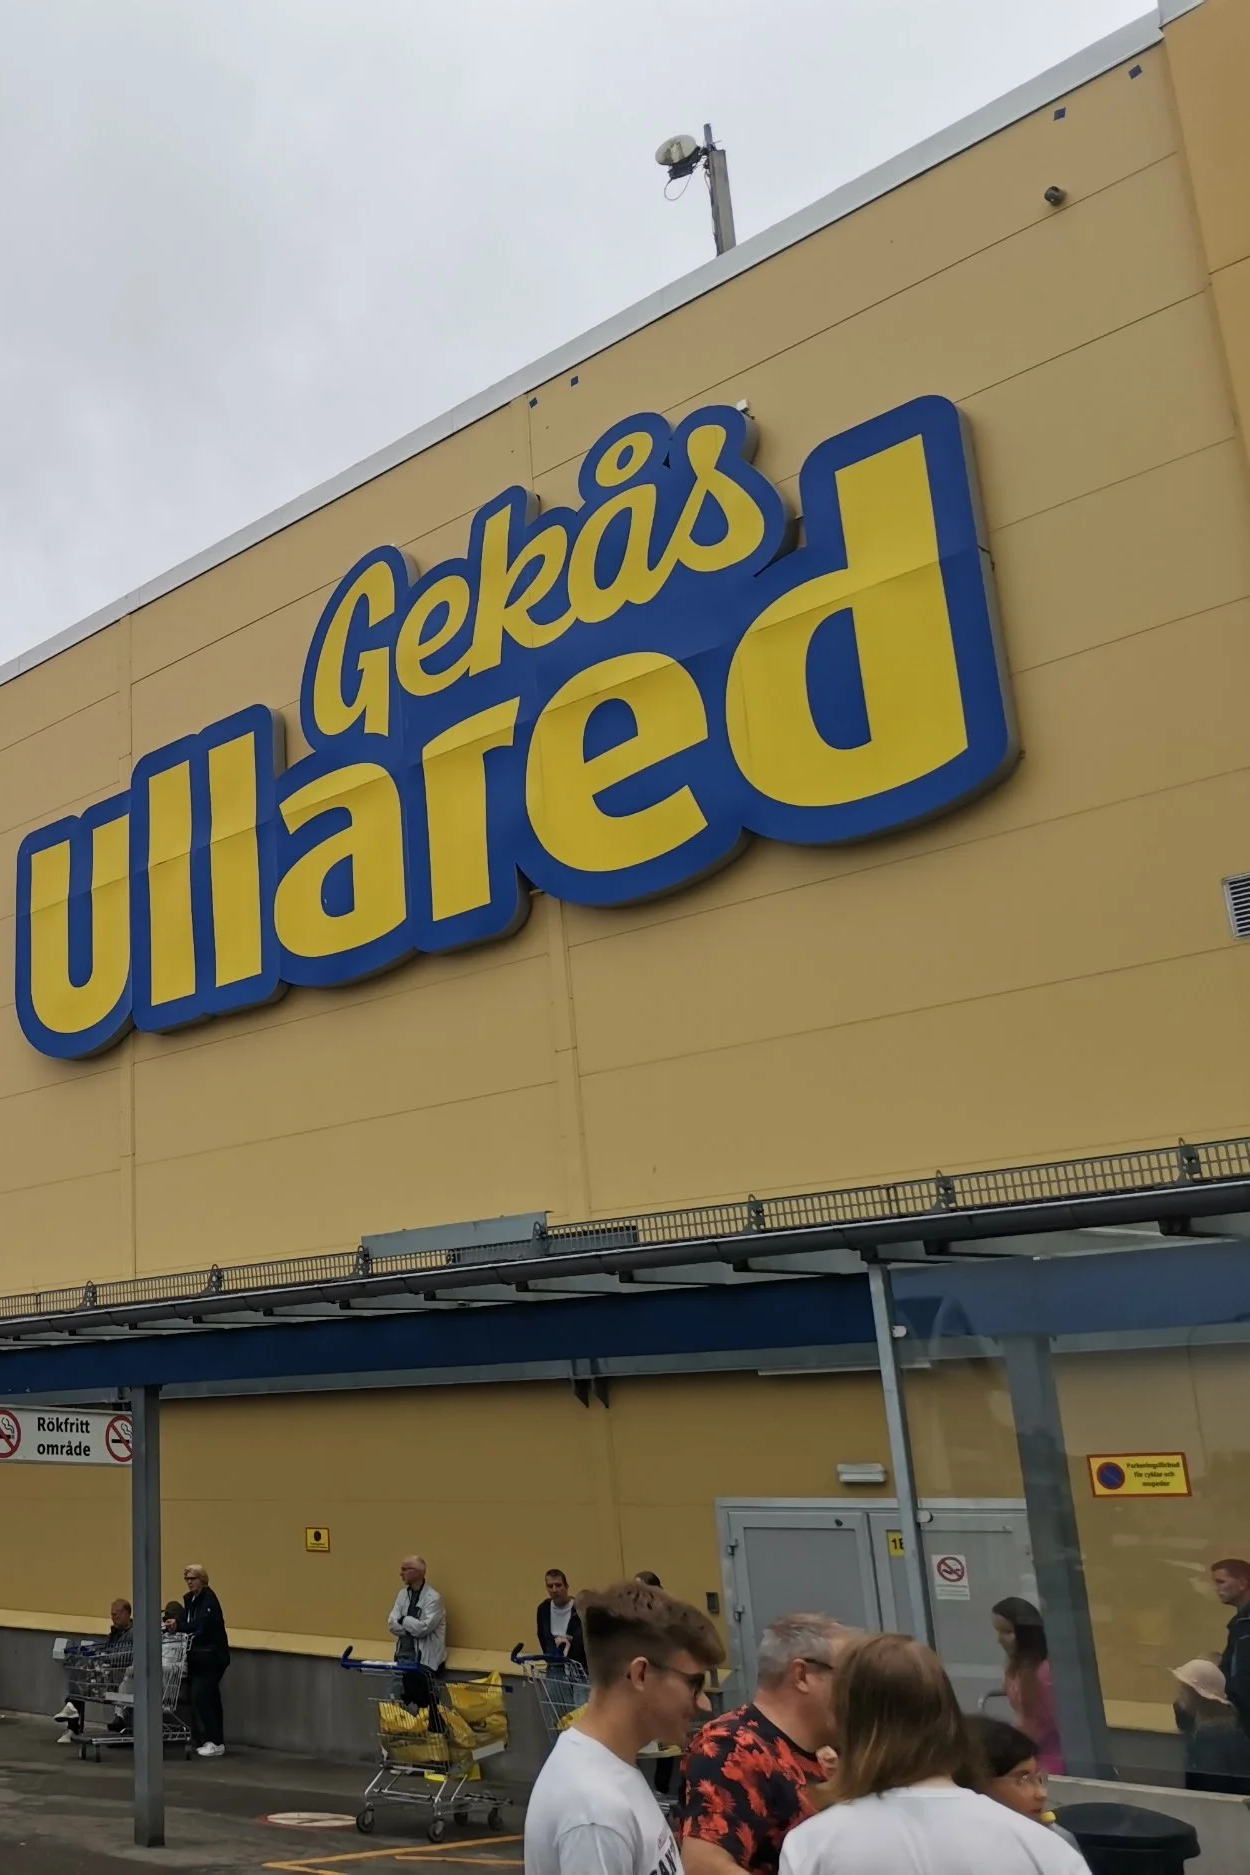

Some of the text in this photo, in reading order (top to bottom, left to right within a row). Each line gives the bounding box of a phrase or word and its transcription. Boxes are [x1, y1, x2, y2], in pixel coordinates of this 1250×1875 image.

[314, 424, 765, 738] Gekås
[30, 433, 969, 1035] Ullared
[37, 1417, 90, 1433] Rökfritt
[37, 1441, 91, 1456] område
